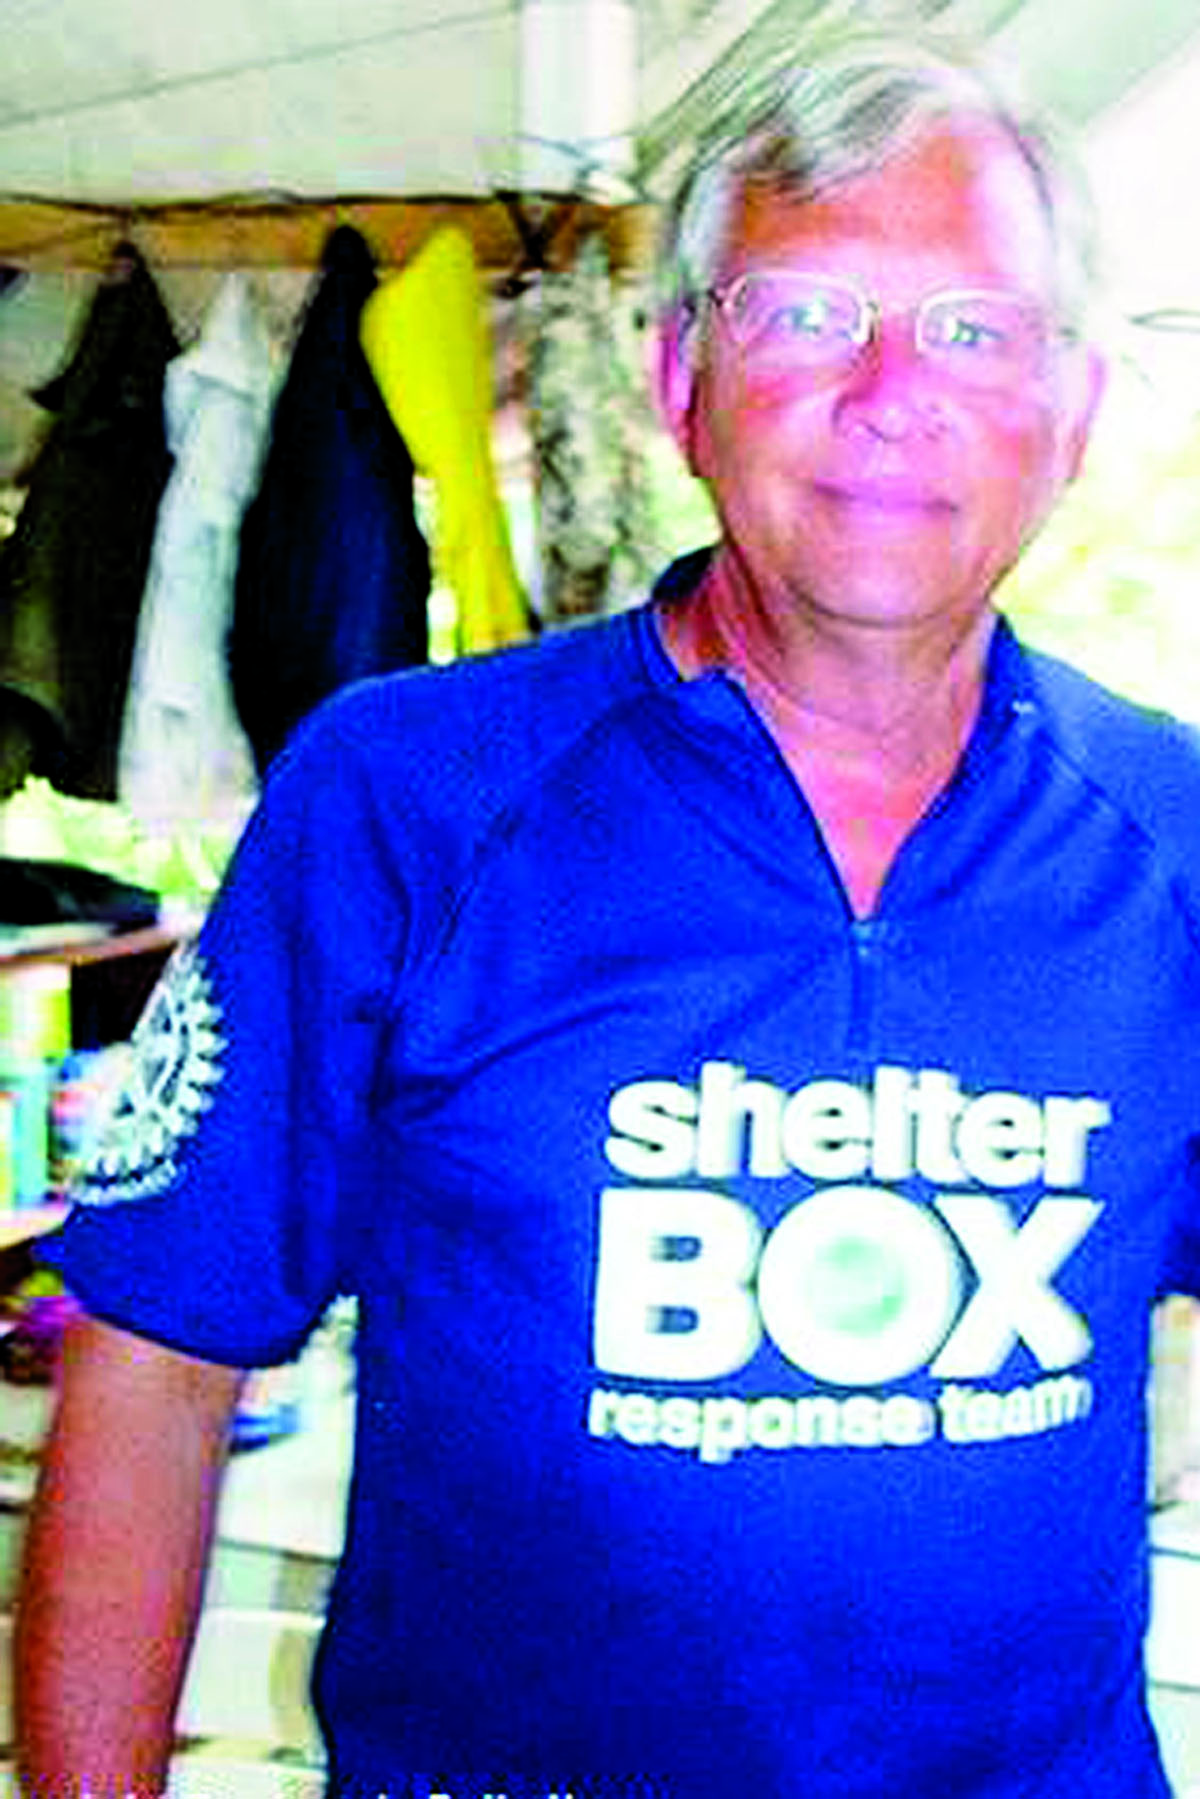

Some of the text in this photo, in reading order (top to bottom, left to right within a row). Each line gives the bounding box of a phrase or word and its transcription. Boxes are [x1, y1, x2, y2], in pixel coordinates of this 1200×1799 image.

[604, 1061, 1112, 1188] shelter
[594, 1184, 1105, 1387] BOX
[589, 1375, 1094, 1463] response team
